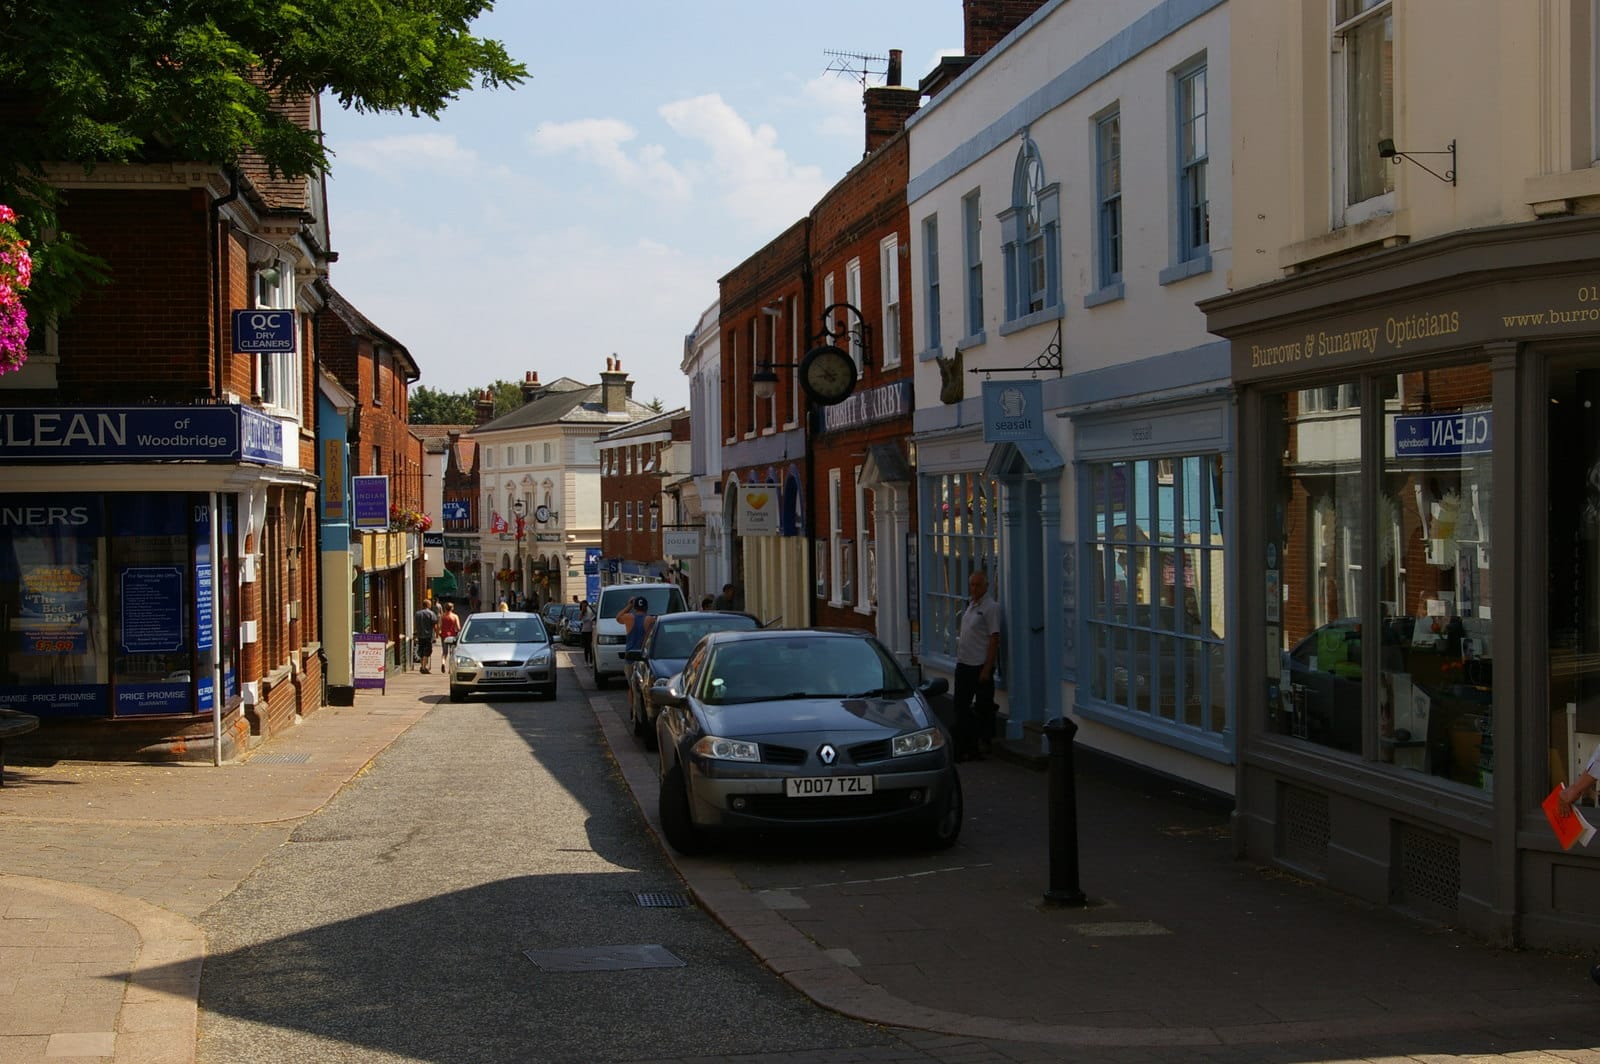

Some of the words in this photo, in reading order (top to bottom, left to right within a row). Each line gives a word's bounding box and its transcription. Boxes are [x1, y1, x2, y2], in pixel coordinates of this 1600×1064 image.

[251, 314, 281, 330] QC
[1503, 307, 1600, 328] www.burro
[241, 340, 290, 348] CLEANERS
[1251, 342, 1301, 368] Burrows
[1304, 333, 1315, 358] &
[1318, 326, 1379, 357] Sunaway
[1386, 310, 1460, 348] Opticians
[860, 391, 867, 421] &
[870, 382, 903, 418] KIRBY
[0, 413, 127, 446] LEAN
[174, 417, 191, 429] of
[994, 418, 1032, 430] seasalt
[137, 434, 227, 447] Woodbridge
[2, 507, 89, 526] NERS
[194, 505, 210, 522] DR
[43, 604, 66, 613] Bed
[32, 693, 57, 702] PRICE
[58, 692, 97, 701] PROMISE
[119, 692, 145, 701] PRICE
[146, 690, 186, 700] PROMISE
[794, 779, 833, 794] YD07
[837, 777, 867, 793] TZL
